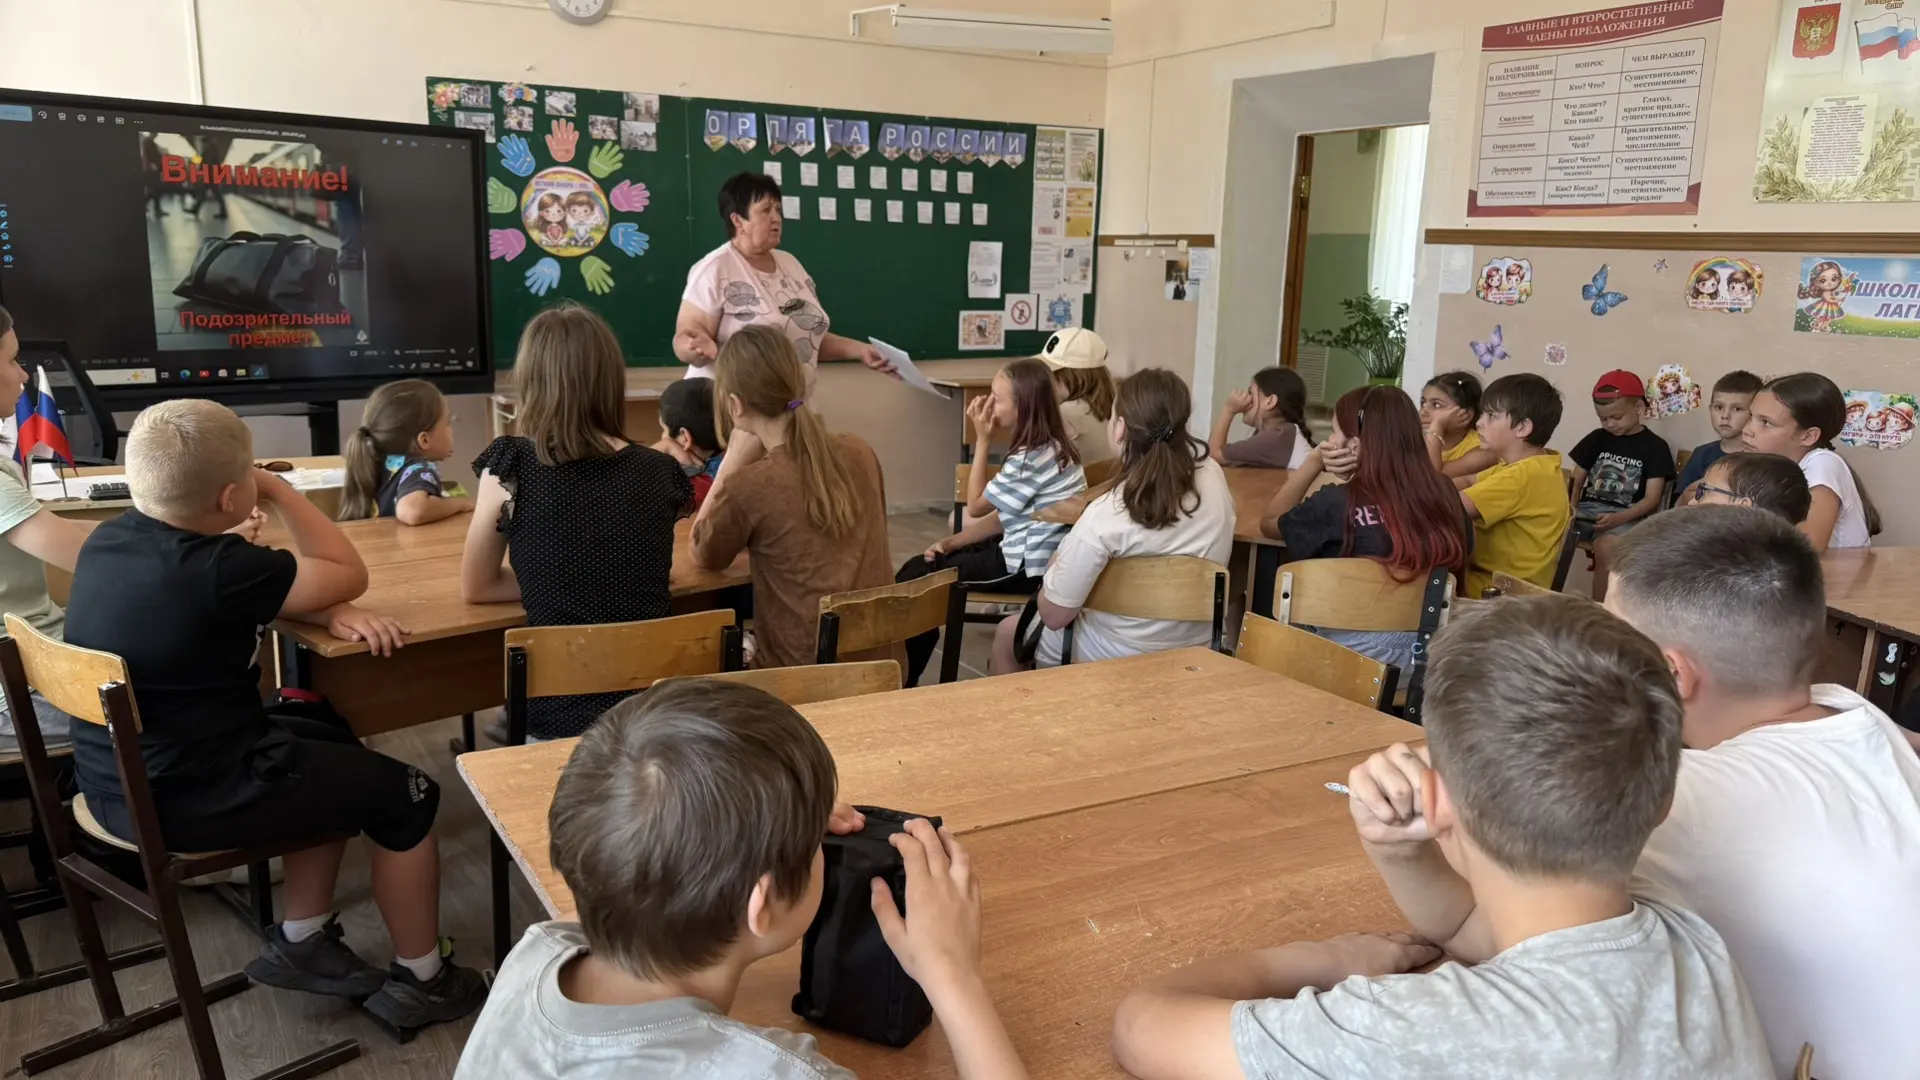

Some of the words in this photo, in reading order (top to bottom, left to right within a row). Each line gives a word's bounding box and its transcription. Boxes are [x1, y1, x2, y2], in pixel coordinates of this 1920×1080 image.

[1506, 20, 1558, 35] ГЛАВНЫЕ
[1560, 18, 1569, 27] И
[1572, 0, 1695, 25] ВТОРОСТЕПЕННЫЕ
[1526, 29, 1566, 43] ЧЛЕНЫ
[1569, 16, 1666, 37] ПРЕДЛОЖЕНИЯ
[1650, 50, 1695, 60] ВЫРАЖЕН?
[1504, 64, 1540, 74] НАЗВАНИЕ
[1575, 60, 1604, 69] ВОПРОС
[1495, 69, 1554, 81] ПОДЧЕРКИВАНИЕ
[1624, 69, 1697, 82] Существительное,
[1569, 83, 1586, 91] Кто?
[1633, 78, 1686, 88] местоимение
[1578, 101, 1606, 109] делает?
[1622, 110, 1690, 121] существительное
[886, 128, 1019, 153] РОССИИ
[1625, 141, 1680, 149] числительное
[161, 154, 349, 192] Внимание!
[1855, 282, 1920, 298] ШКОЛ
[179, 309, 352, 329] Подозрительный
[228, 331, 313, 348] предмет
